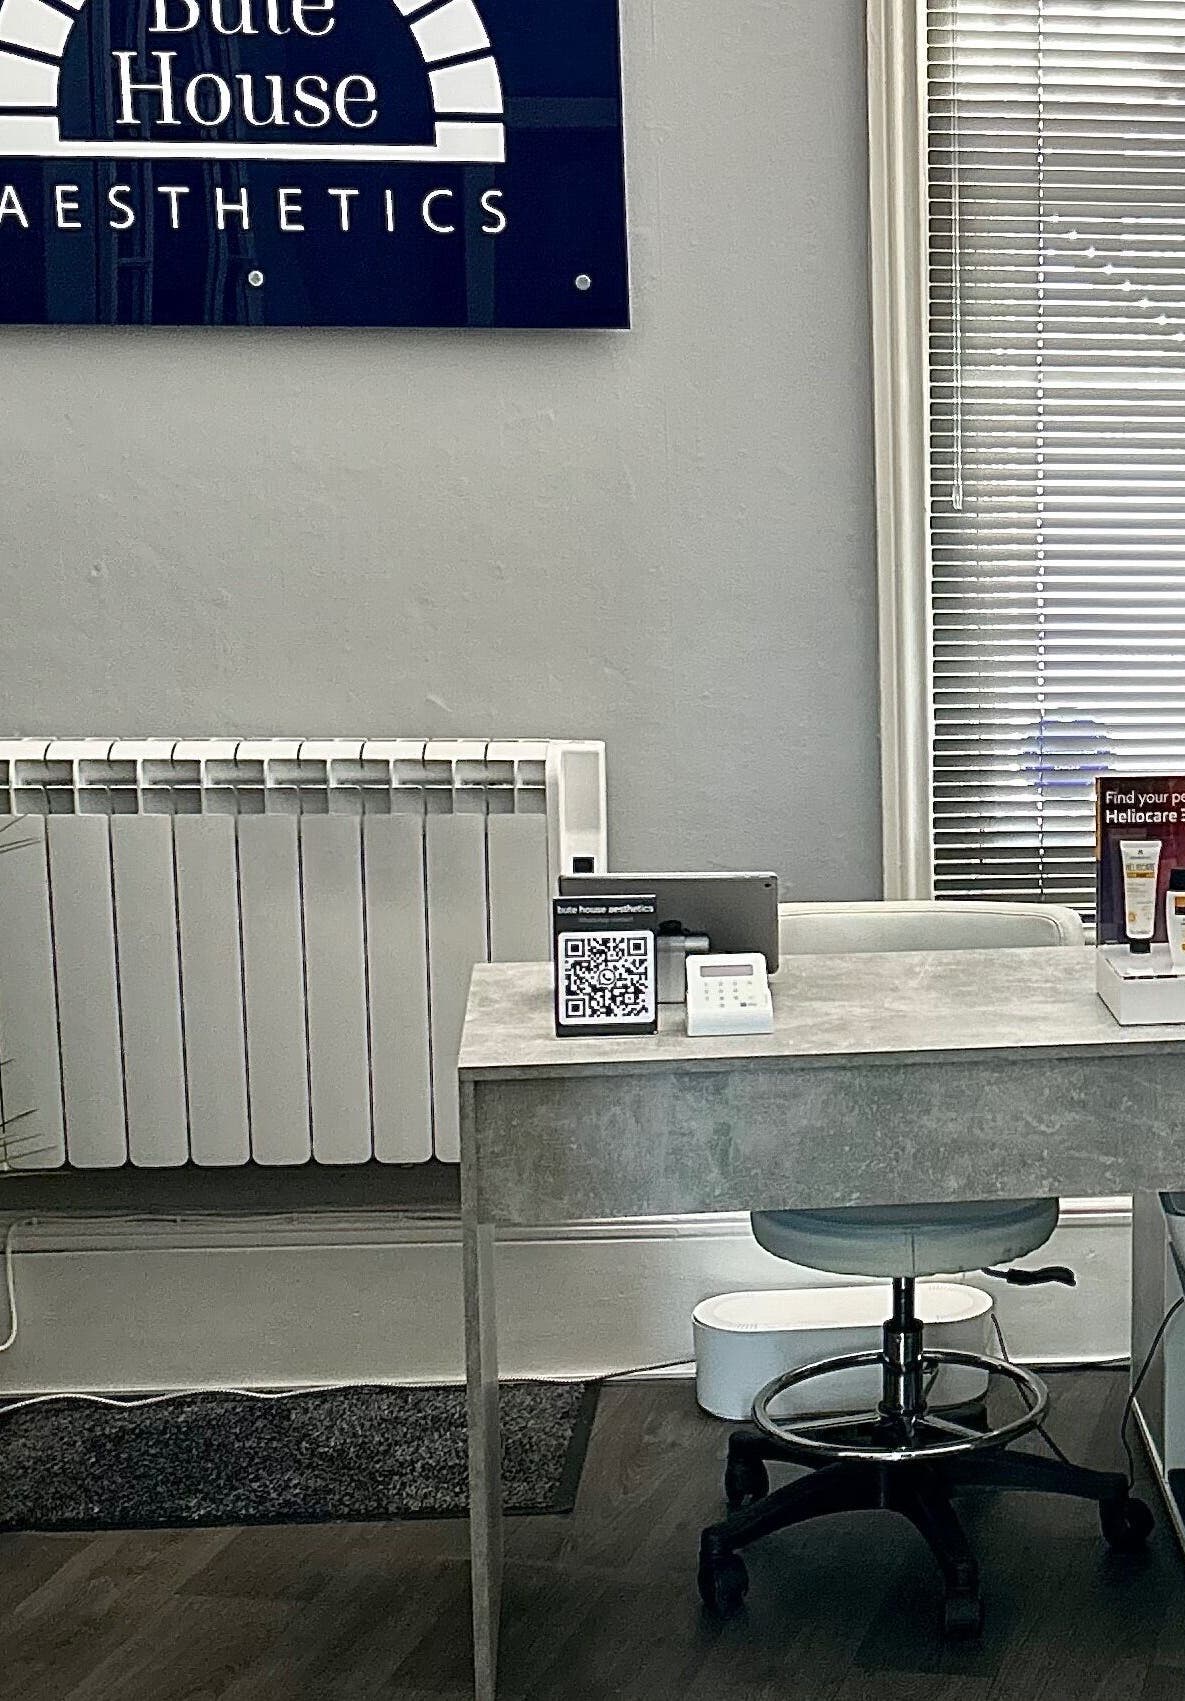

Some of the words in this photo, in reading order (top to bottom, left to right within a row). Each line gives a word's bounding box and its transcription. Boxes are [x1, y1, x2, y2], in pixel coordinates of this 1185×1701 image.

[112, 50, 379, 128] House
[0, 185, 508, 233] AESTHETICS
[1105, 790, 1135, 804] Find
[1137, 792, 1169, 807] your
[1105, 808, 1178, 823] Heliocare
[557, 905, 578, 915] bute
[579, 905, 607, 914] house
[608, 903, 655, 914] aesthetics
